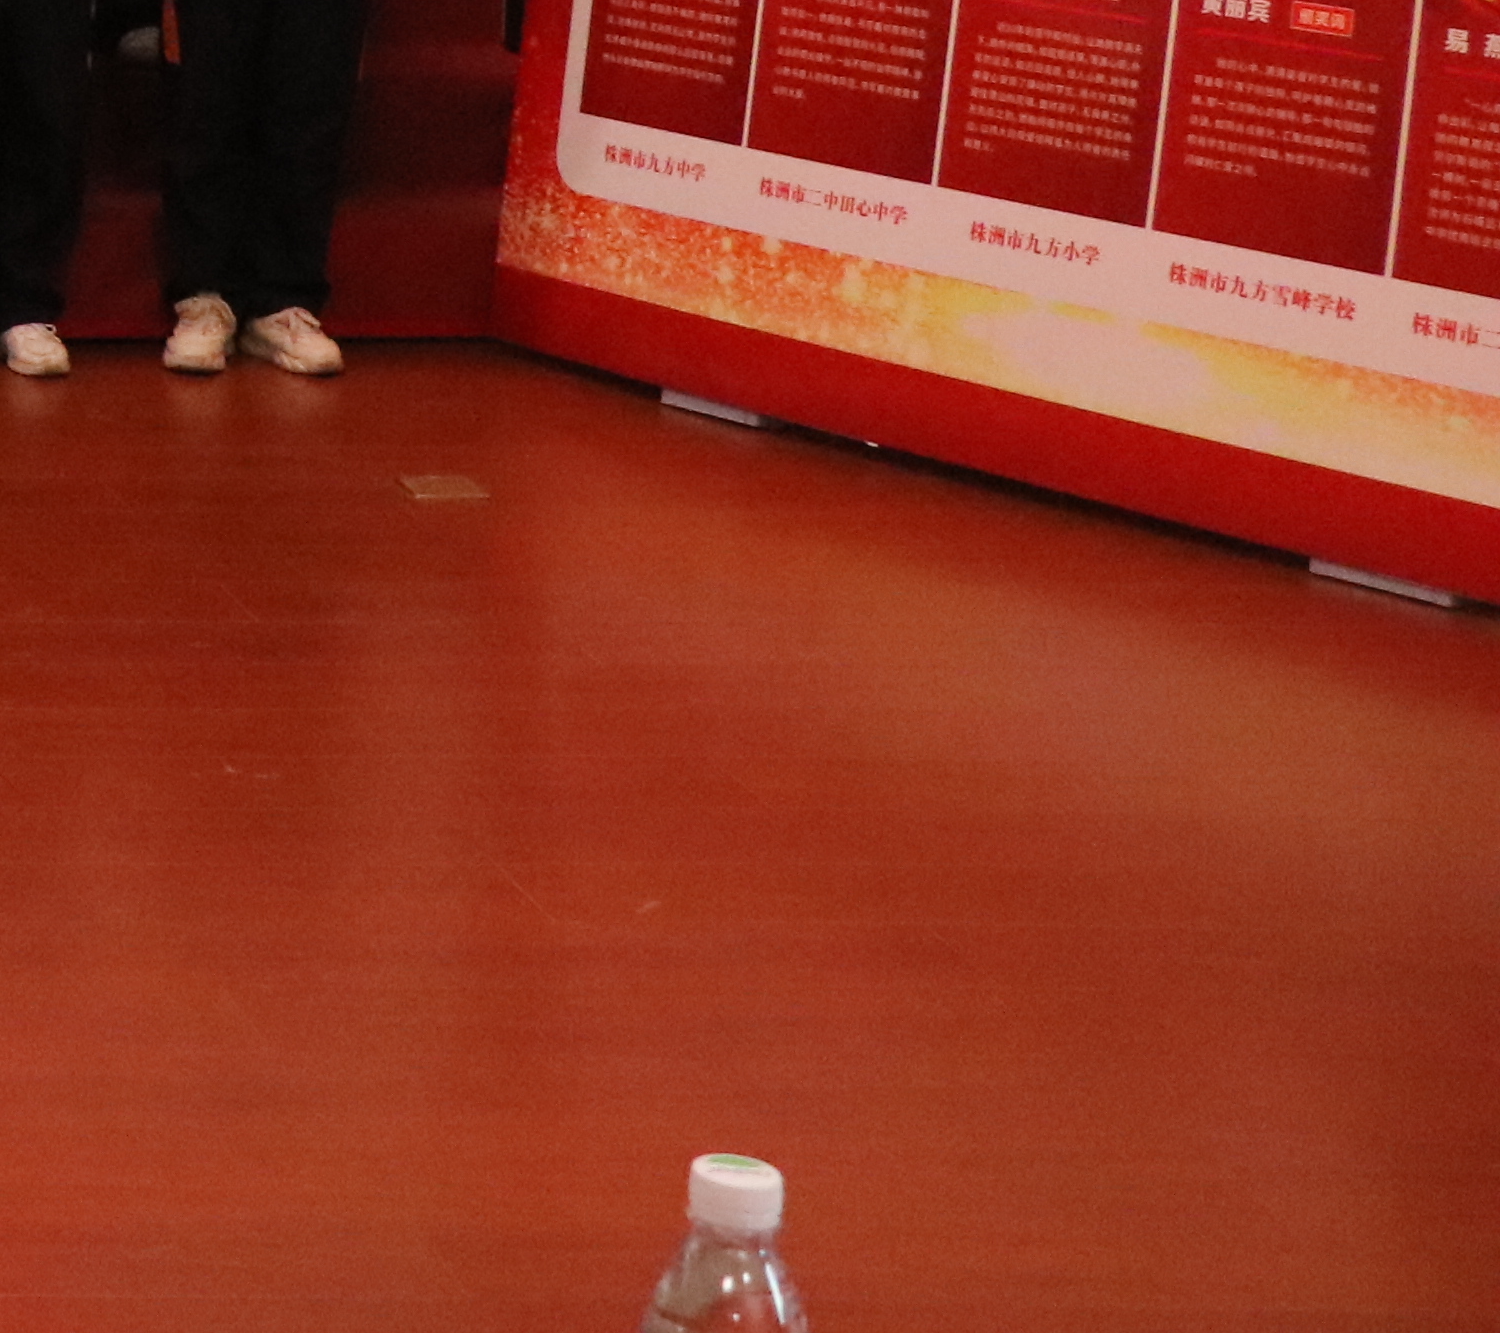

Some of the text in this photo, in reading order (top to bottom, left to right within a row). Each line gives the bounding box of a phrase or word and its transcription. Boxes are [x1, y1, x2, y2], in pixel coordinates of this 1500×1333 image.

[605, 143, 706, 181] 株洲市九方中学
[760, 177, 908, 224] 株洲市二中田心中学
[969, 221, 1101, 267] 株洲市九方小学
[1169, 262, 1357, 321] 株洲市九方雪峰学校
